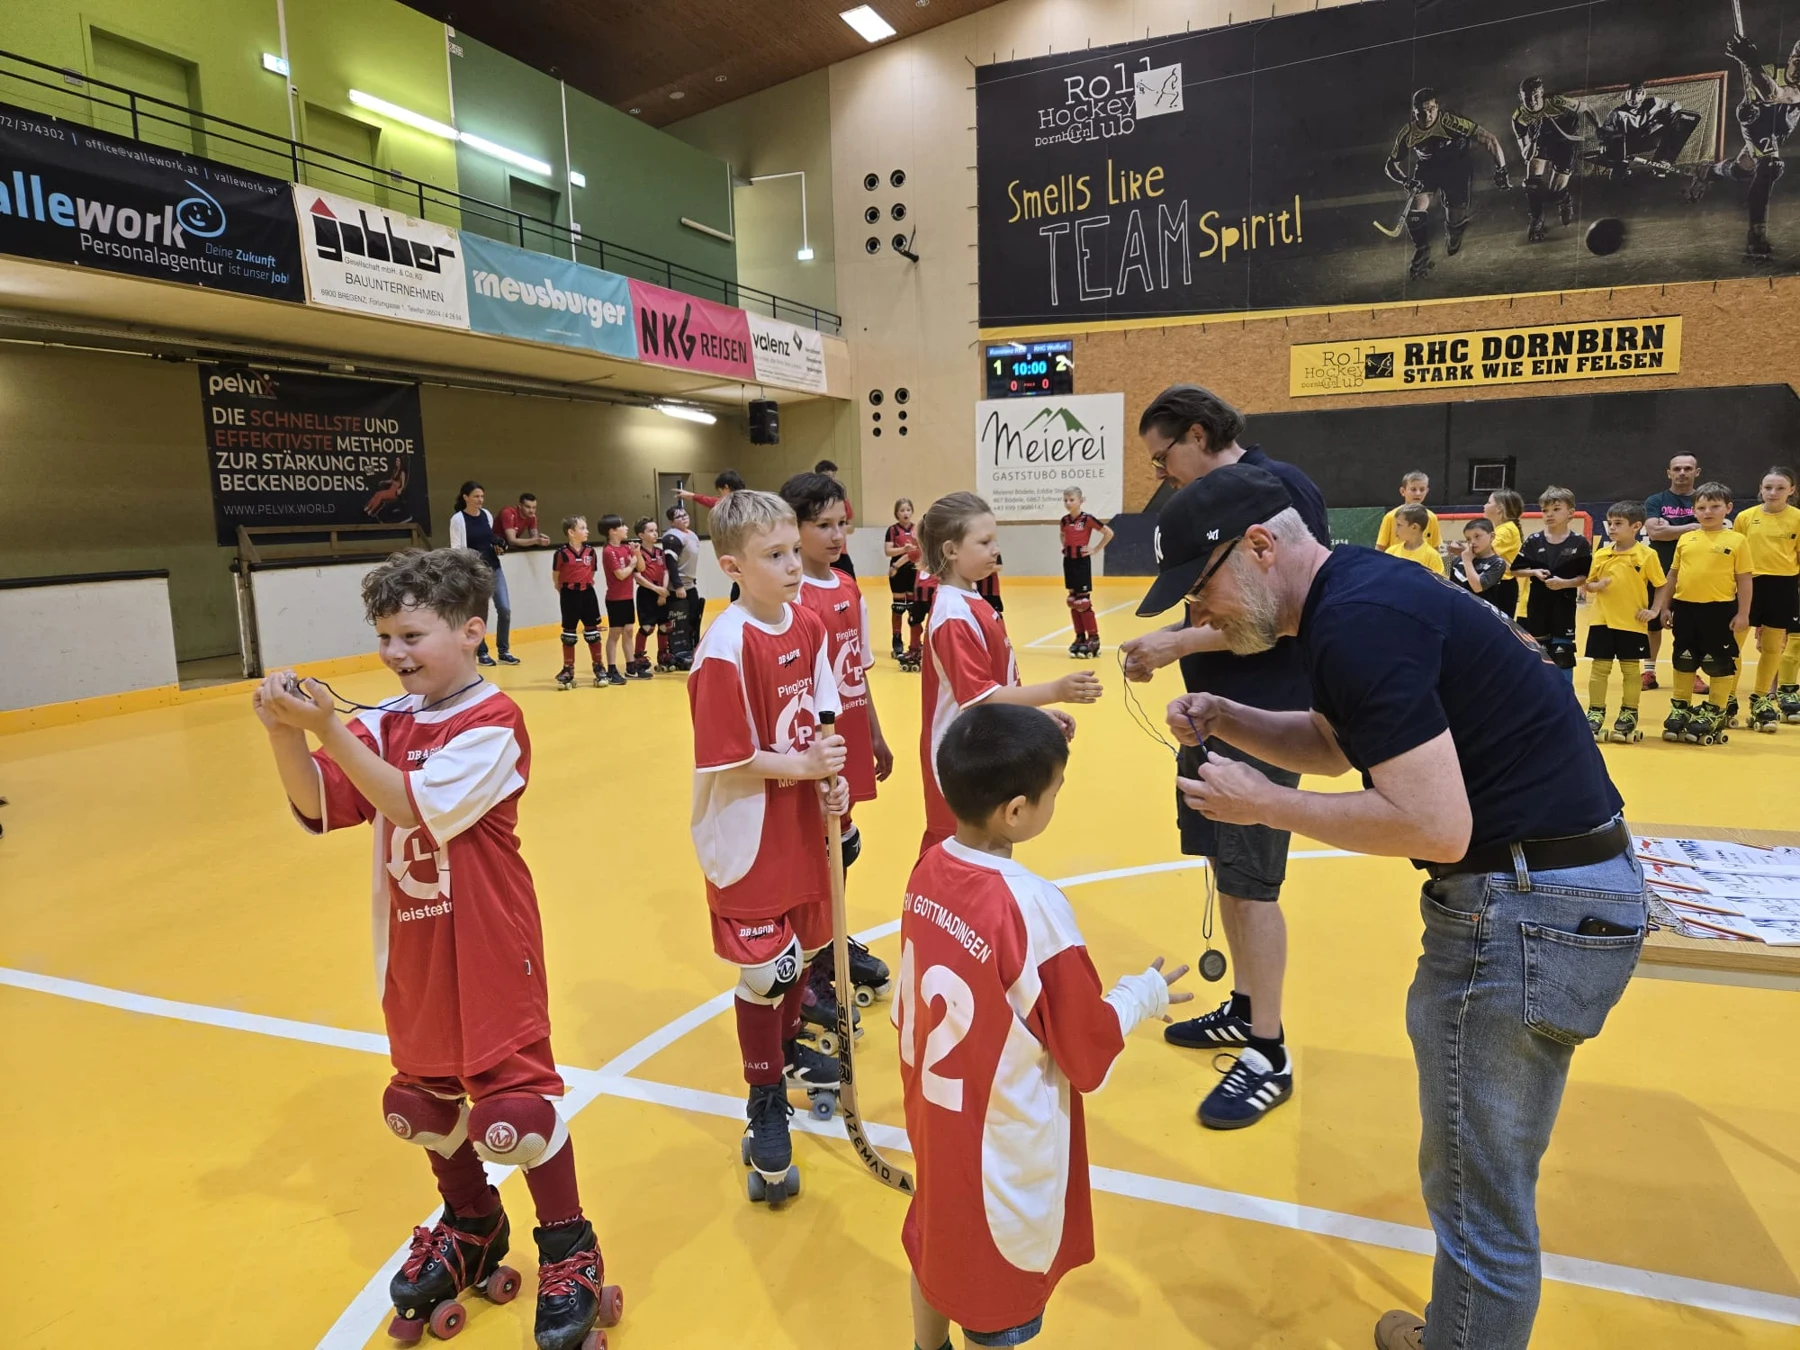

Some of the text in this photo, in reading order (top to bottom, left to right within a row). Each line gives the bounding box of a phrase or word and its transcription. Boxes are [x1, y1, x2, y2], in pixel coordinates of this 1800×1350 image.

[1038, 95, 1136, 129] Hockey
[1035, 128, 1090, 146] Dornbirn
[1067, 114, 1135, 143] Club
[86, 139, 198, 175] office@vallework.at
[214, 172, 278, 196] vallework.at
[1008, 159, 1164, 223] Smells Like
[80, 233, 223, 276] Personalagentur
[205, 242, 276, 267] Deine Zukunft
[1039, 195, 1302, 306] TEAM Spirit!
[229, 263, 290, 285] ist unser Job!
[344, 257, 380, 271] Gesellschaft
[345, 272, 445, 302] BAUUNTERNEHMEN
[472, 269, 625, 328] meusburger
[641, 303, 747, 364] NKG REISEN
[752, 332, 790, 357] valenz
[1404, 324, 1665, 367] RHC DORNBIRN
[993, 360, 1002, 375] 1
[1012, 360, 1047, 376] 10:00
[1056, 355, 1067, 371] 2
[1305, 365, 1365, 379] Hockey
[1403, 351, 1664, 384] STARK WIE EIN FELSEN
[209, 372, 276, 396] pelvix
[1010, 380, 1018, 391] 0
[1042, 378, 1049, 389] 0
[212, 407, 399, 434] DIE SCHNELLSTE UND
[215, 430, 414, 454] EFFEKTIVSTE METHODE
[982, 411, 1105, 466] Meierei
[216, 450, 388, 473] ZUR STÄRKUNG DES
[219, 474, 369, 491] BECKENBODENS.
[992, 468, 1105, 481] GASTSTUBÖ BÖDELE
[223, 503, 335, 515] WWW.PELVIX.WORLD
[739, 924, 774, 937] DRAGON
[914, 895, 992, 964] GOTTMADINGEN
[901, 937, 975, 1112] 12
[837, 1005, 853, 1085] SUPER
